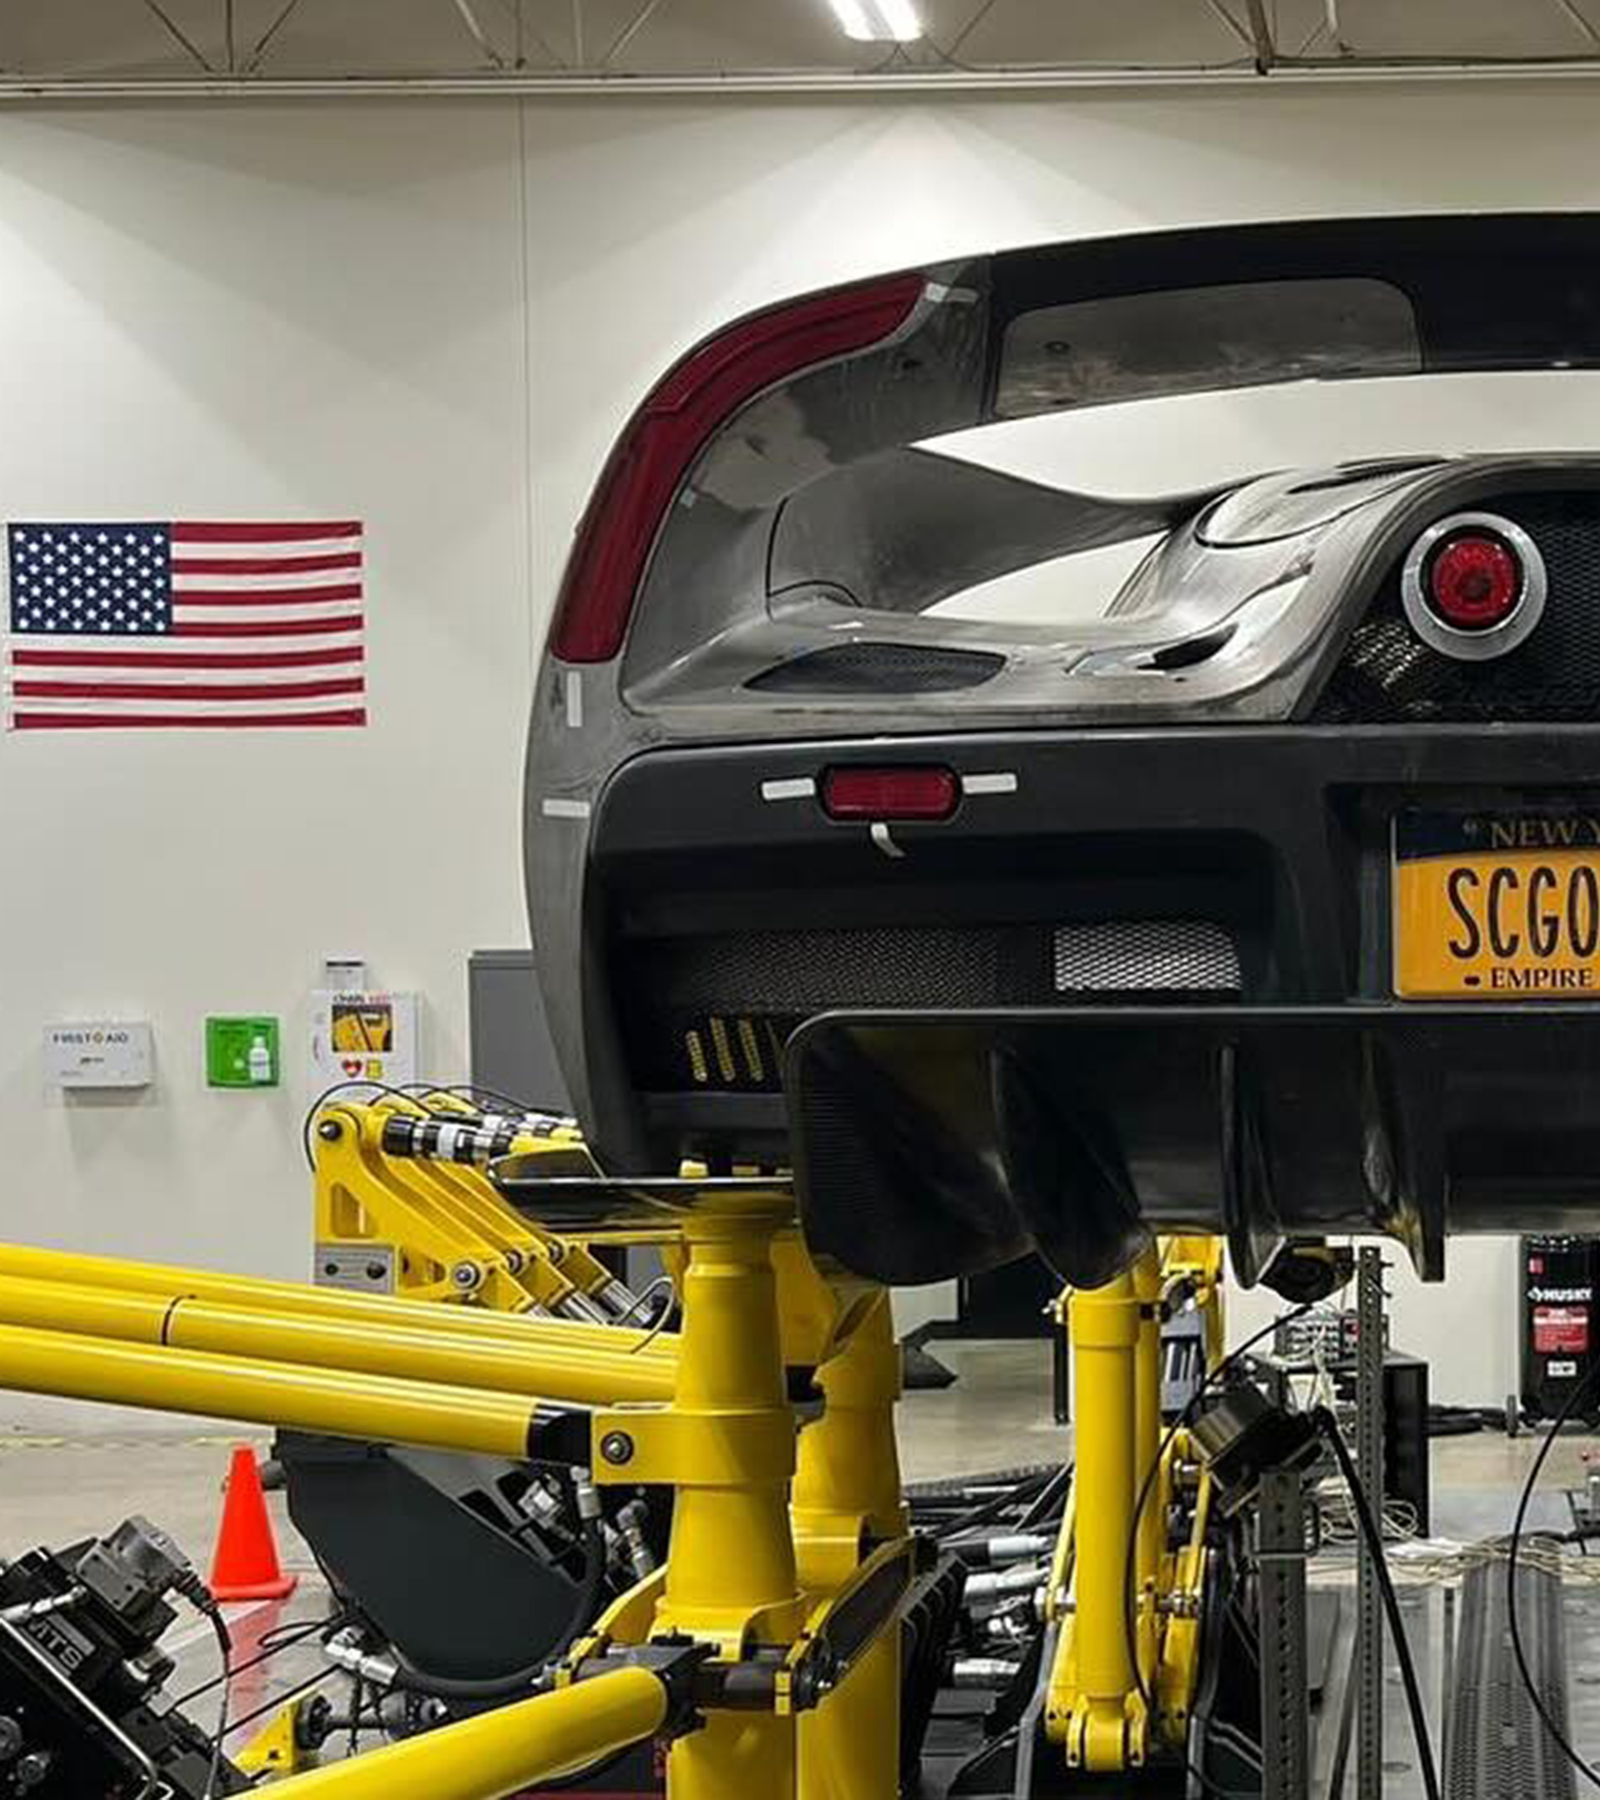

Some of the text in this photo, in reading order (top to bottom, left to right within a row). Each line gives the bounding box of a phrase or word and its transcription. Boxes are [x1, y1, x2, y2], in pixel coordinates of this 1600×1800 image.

[1490, 820, 1578, 848] NEW
[1490, 967, 1593, 989] EMPIRE
[1543, 1288, 1592, 1301] HUSKY
